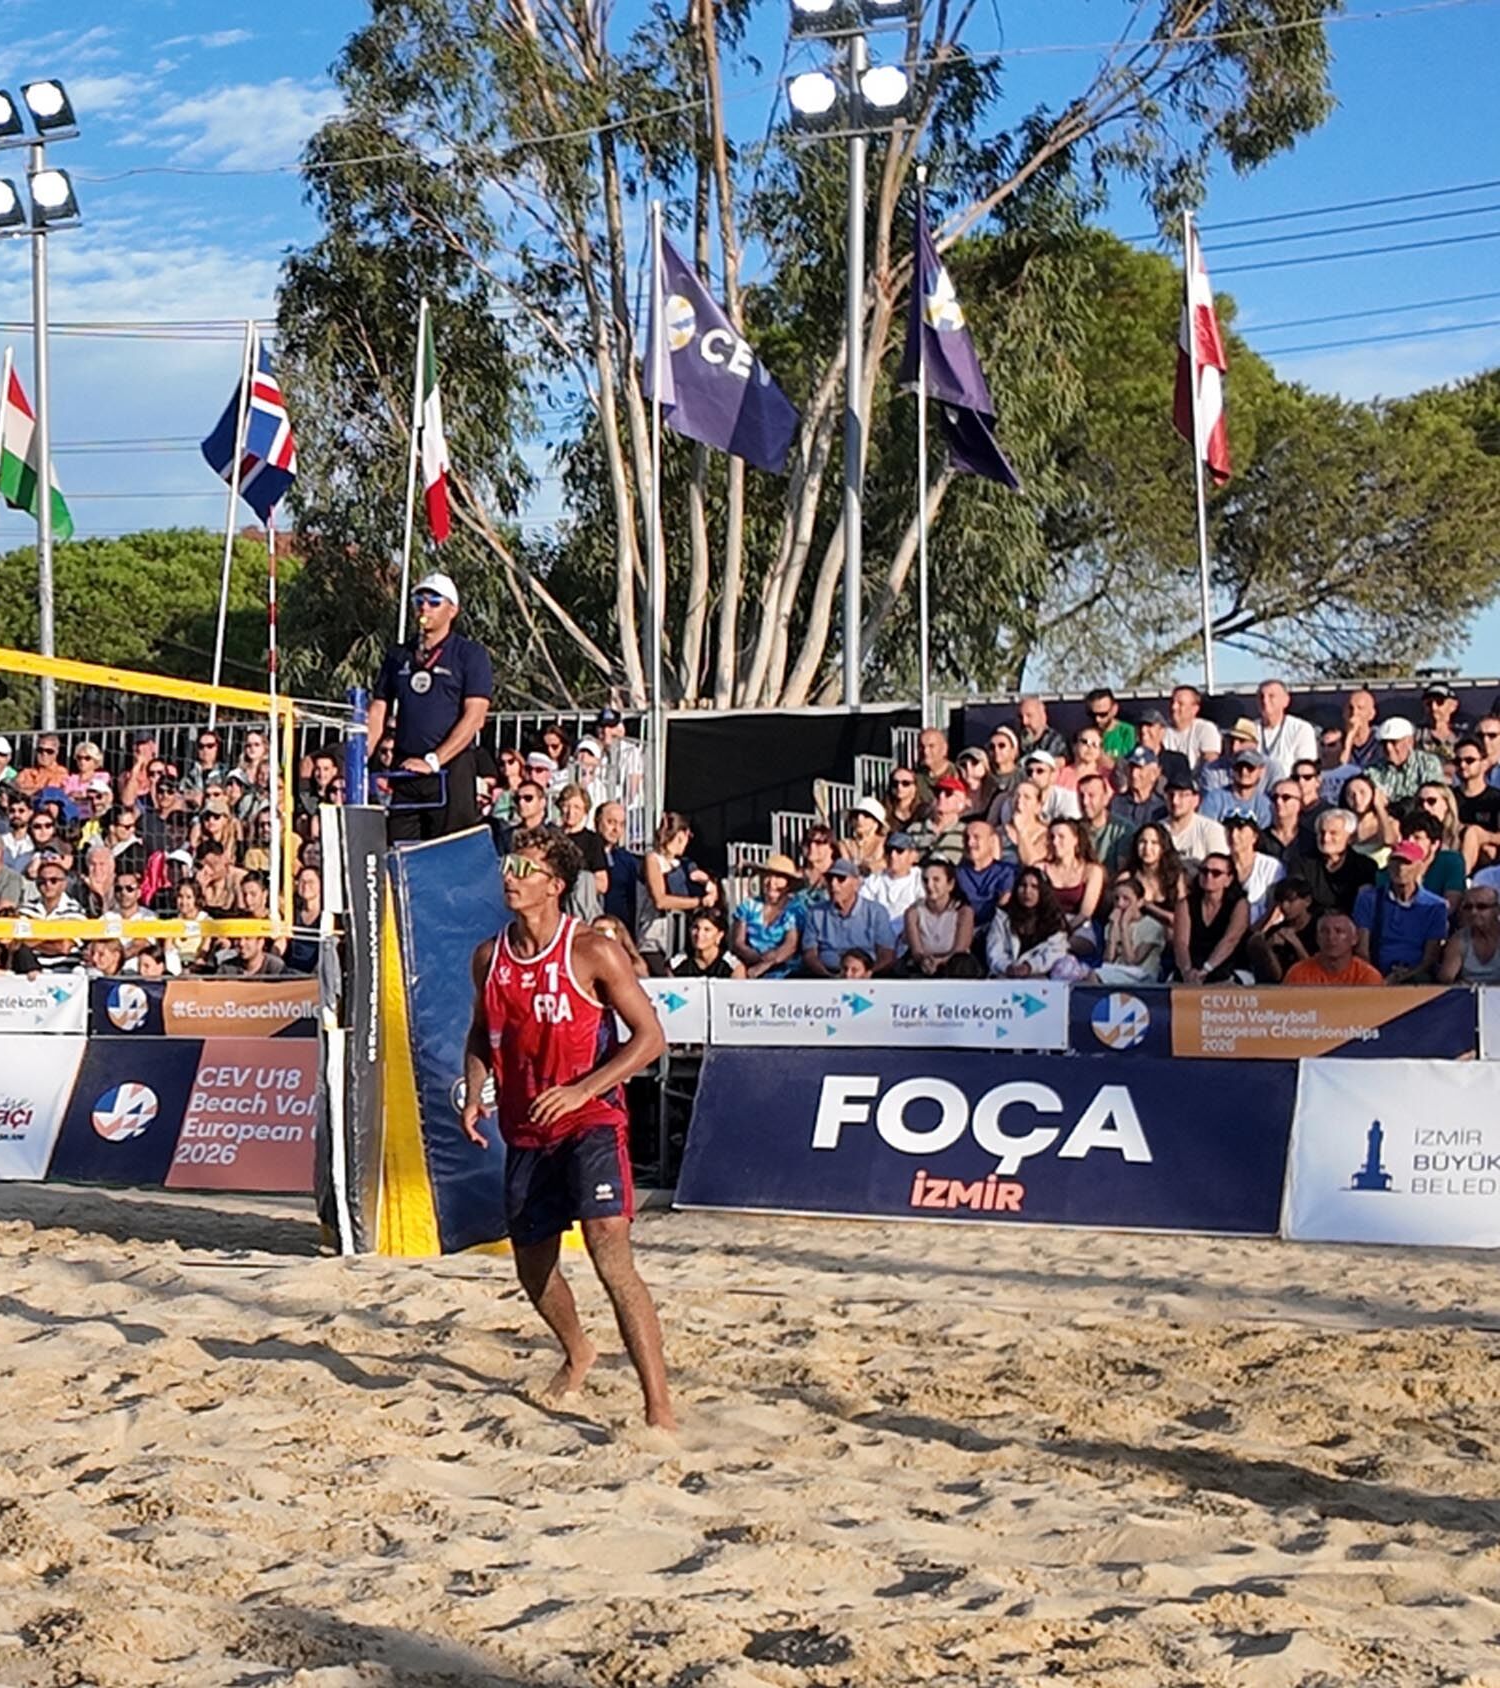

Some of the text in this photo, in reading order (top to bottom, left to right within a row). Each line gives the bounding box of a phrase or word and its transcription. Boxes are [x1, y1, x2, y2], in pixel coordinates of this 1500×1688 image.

[544, 961, 559, 993] 1
[533, 993, 574, 1024] FRA
[728, 1003, 841, 1018] Türk Telekom
[891, 1004, 1013, 1020] Türk Telekom
[1202, 1009, 1317, 1027] Beach Volleyball
[1202, 1025, 1380, 1041] European Championships
[197, 1067, 302, 1090] CEV U18
[189, 1092, 317, 1115] Beach Vol
[182, 1117, 304, 1144] European
[812, 1075, 1153, 1176] FOÇA
[175, 1143, 238, 1165] 2026
[1413, 1151, 1500, 1171] BÜYÜK
[911, 1170, 1025, 1211] İZMİR
